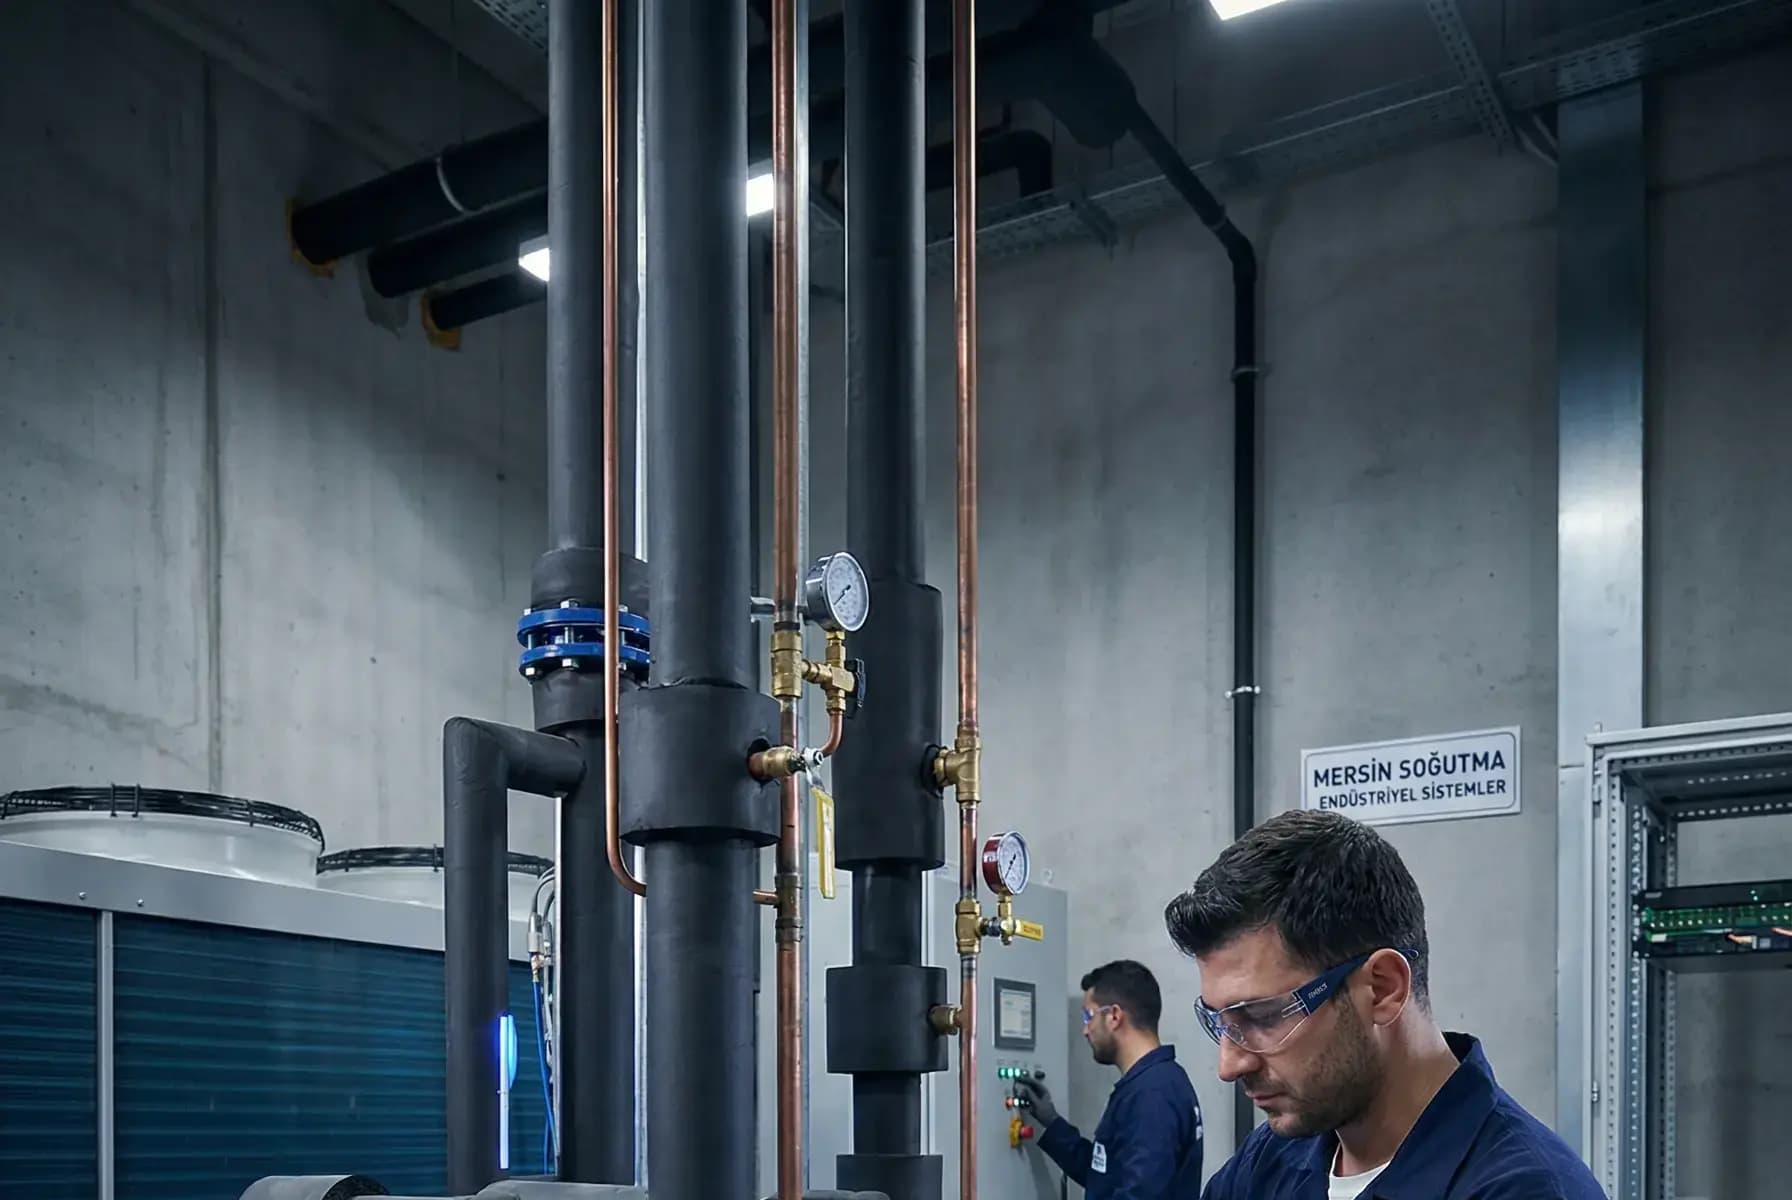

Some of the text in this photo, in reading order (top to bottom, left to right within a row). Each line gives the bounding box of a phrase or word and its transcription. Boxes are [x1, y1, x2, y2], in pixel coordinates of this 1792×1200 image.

[1314, 750, 1506, 788] MERSİN SOĞUTMA
[1319, 780, 1506, 810] ENDÜSTRİYEL SİSTEMLER
